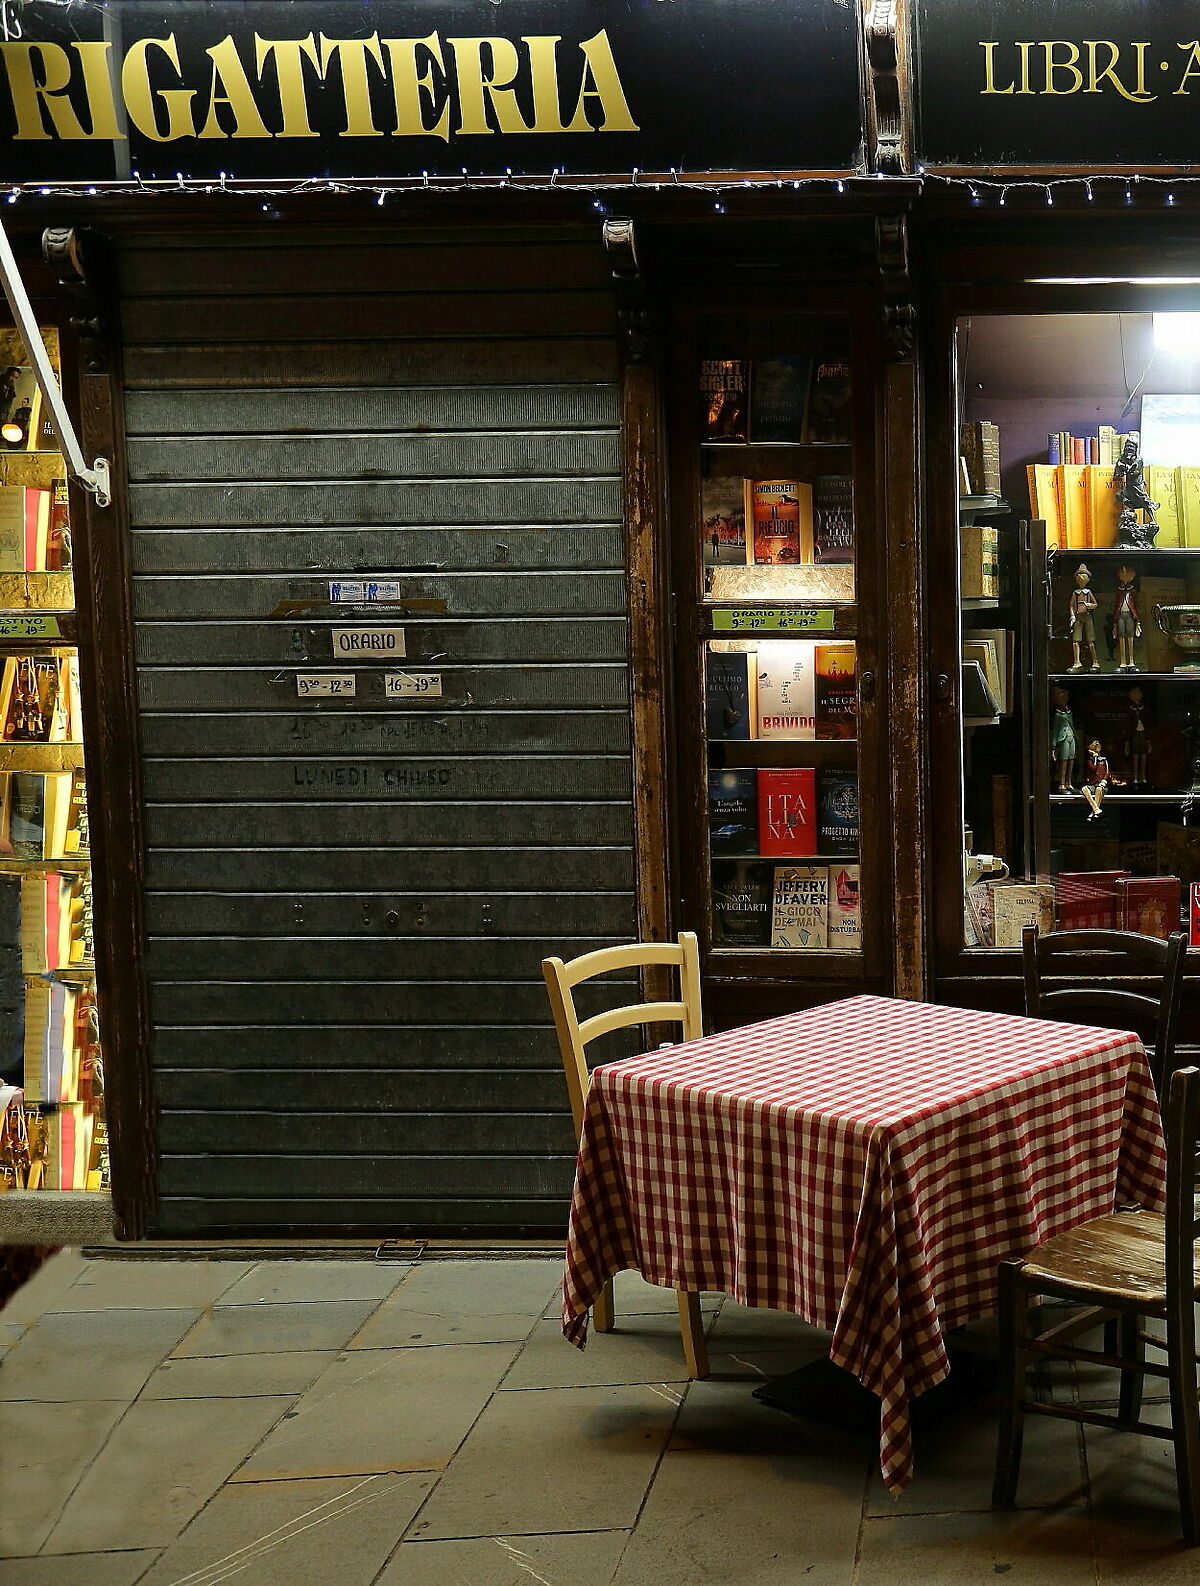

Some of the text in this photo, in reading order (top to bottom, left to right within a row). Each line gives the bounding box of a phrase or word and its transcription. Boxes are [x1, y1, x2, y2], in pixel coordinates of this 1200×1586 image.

[979, 40, 1158, 103] LIBRI
[1, 28, 640, 143] RIGATTERIA
[339, 633, 396, 651] ORARIO
[715, 902, 767, 912] SVEGLIARTI
[775, 893, 828, 905] DEAVER
